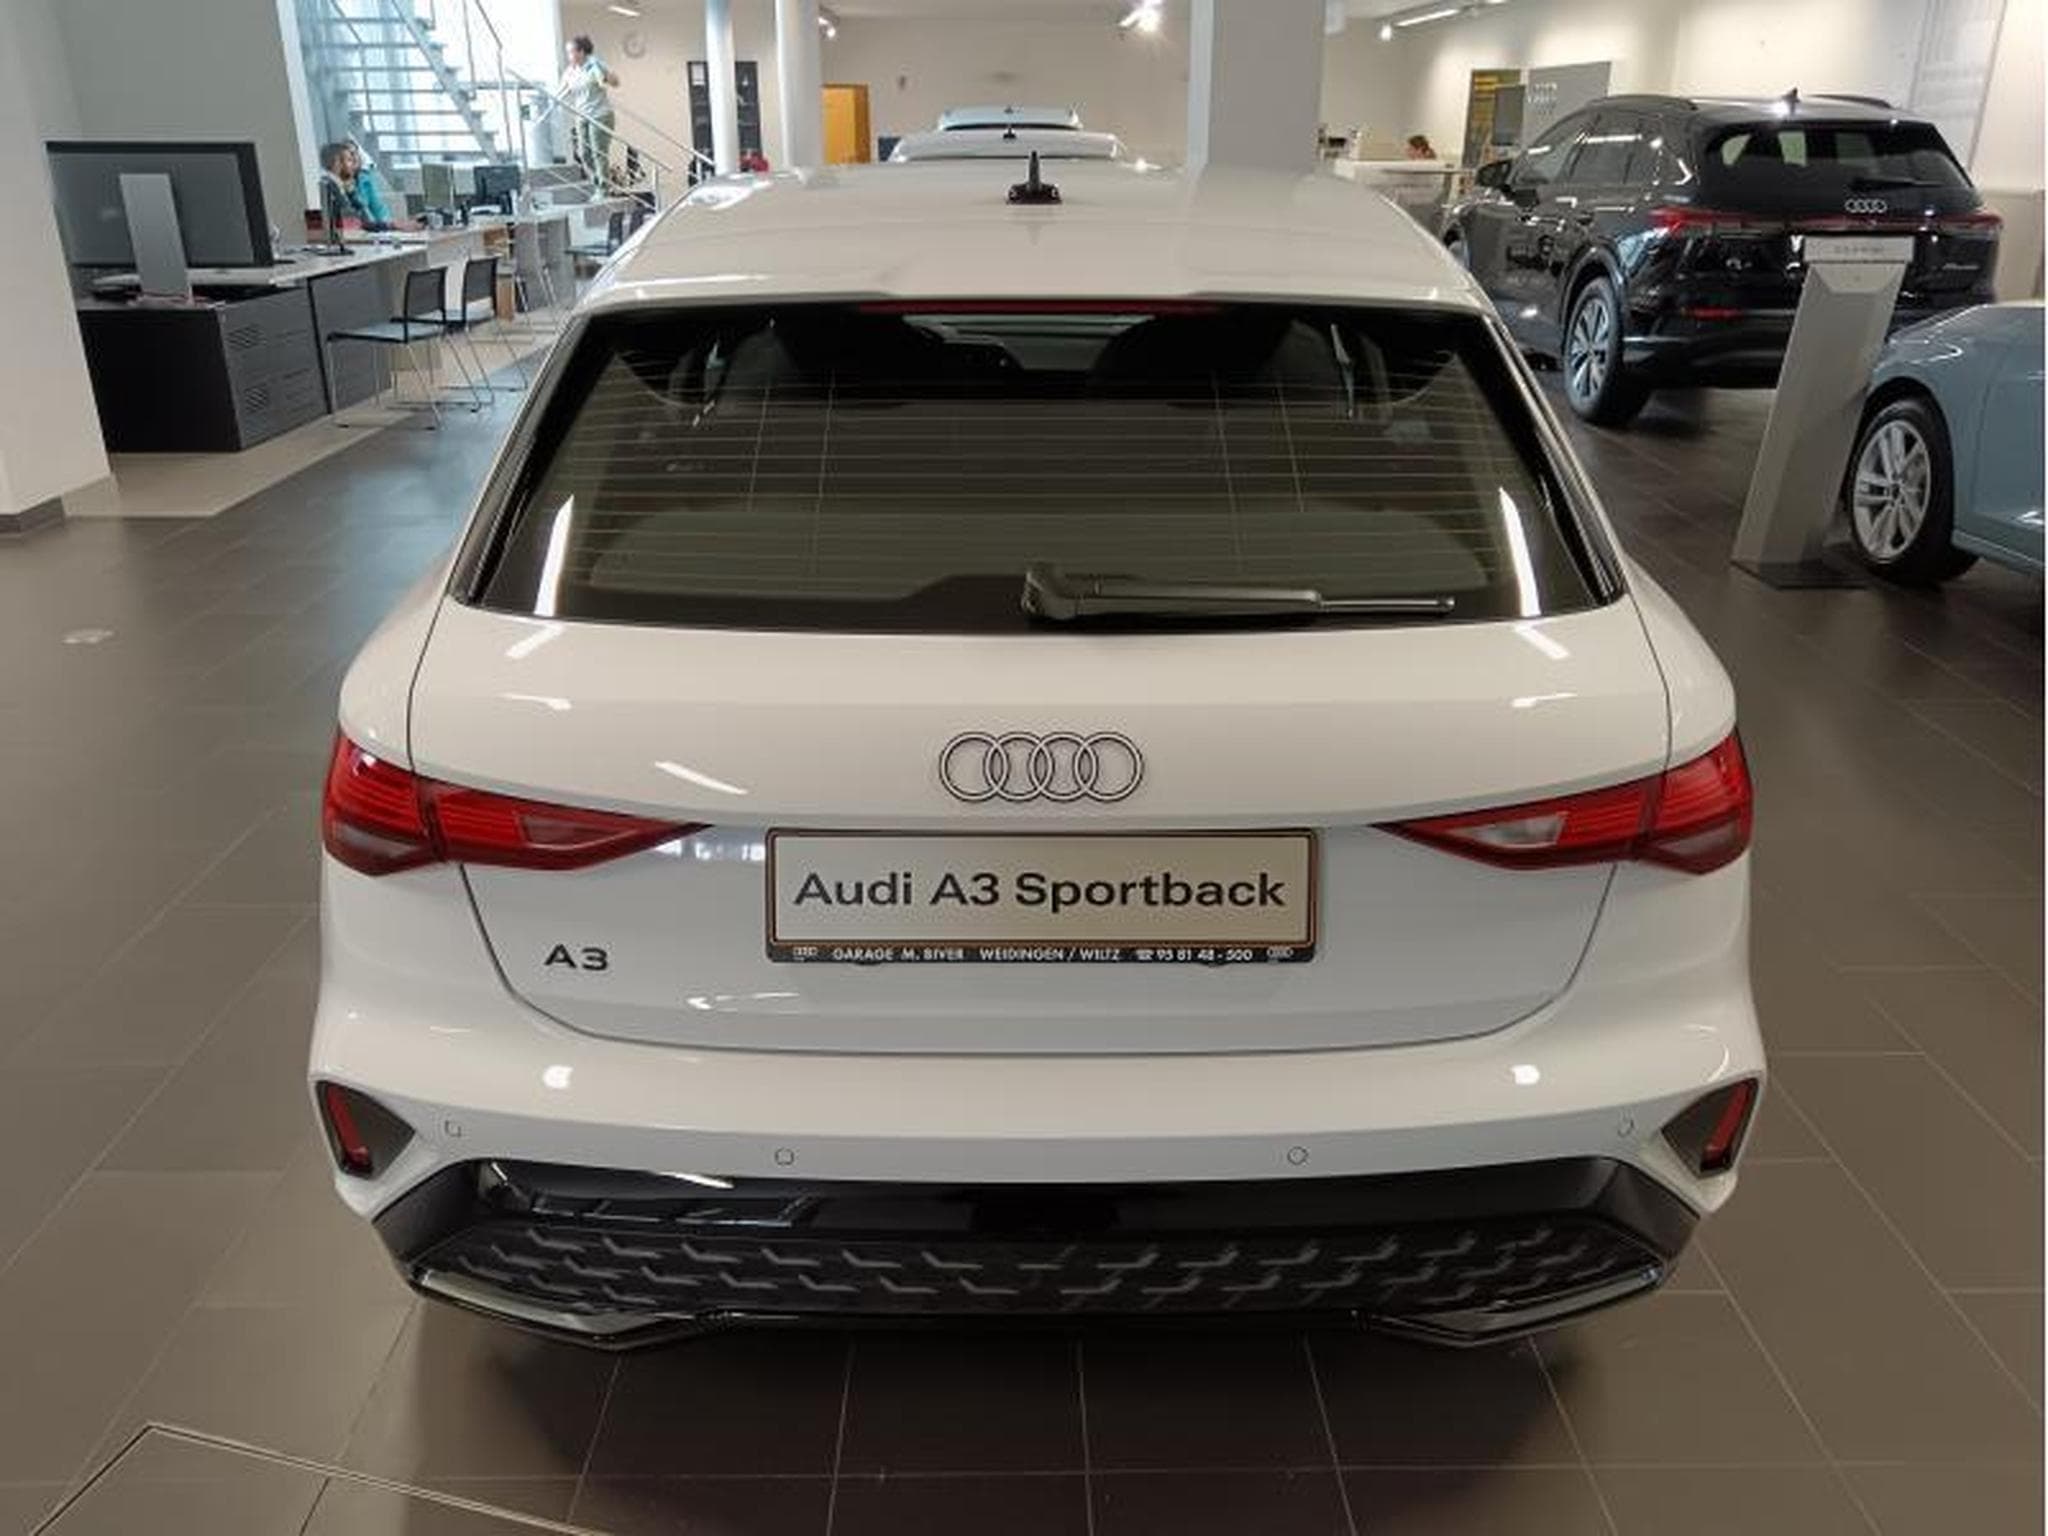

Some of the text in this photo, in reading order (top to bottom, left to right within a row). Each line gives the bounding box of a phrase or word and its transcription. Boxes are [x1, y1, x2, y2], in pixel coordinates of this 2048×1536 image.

[793, 871, 1286, 914] Audi A3 Sportback
[542, 943, 609, 972] A3
[832, 946, 894, 961] GARAGE
[979, 946, 1065, 961] WEIDINGEN
